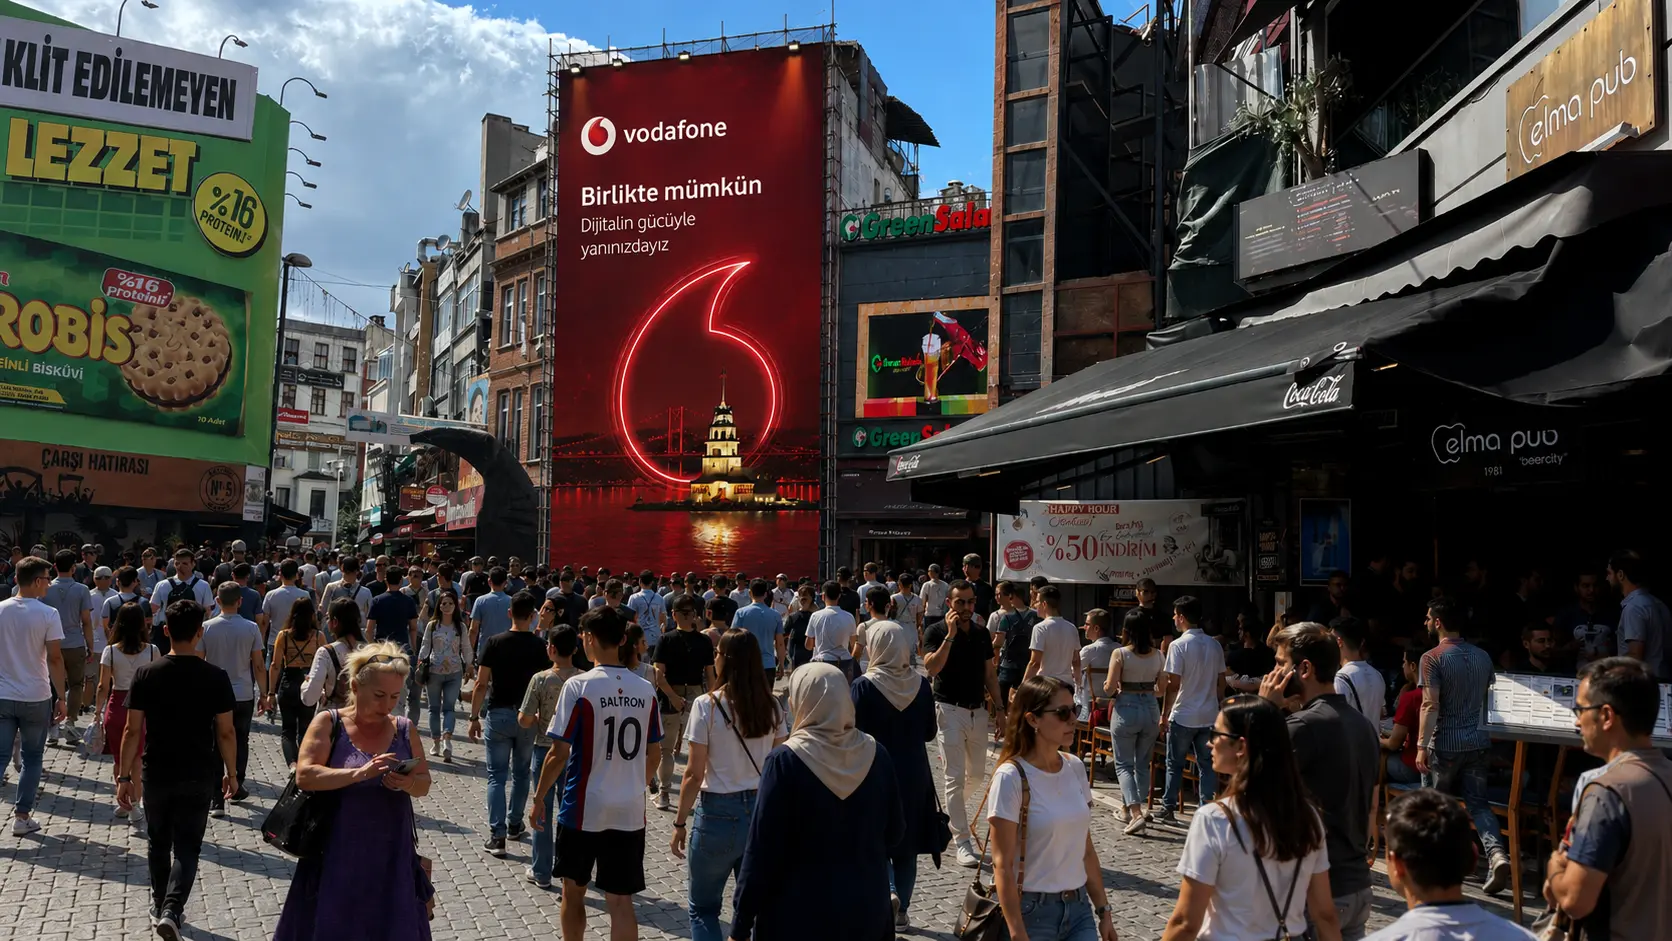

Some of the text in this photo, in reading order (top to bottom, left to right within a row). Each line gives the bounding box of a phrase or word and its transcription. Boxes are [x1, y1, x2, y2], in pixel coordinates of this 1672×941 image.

[72, 47, 237, 121] EDİLEMEYEN
[1530, 49, 1637, 146] elma pub
[624, 119, 727, 144] vodafone
[5, 117, 199, 195] LEZZET
[581, 175, 762, 206] Birlikte mümkün
[210, 186, 257, 229] %16
[581, 211, 696, 235] Dijitalin gücüyle
[581, 238, 669, 260] yanınızdayız
[117, 273, 160, 292] %16
[1283, 374, 1346, 409] Coca-Cola
[1445, 429, 1501, 454] elma
[41, 448, 150, 475] ÇARŞI HATIRASI
[1050, 504, 1118, 514] HAPPY HOUR
[1046, 534, 1098, 561] %50
[600, 696, 645, 709] BALTRON
[603, 715, 642, 761] 10
